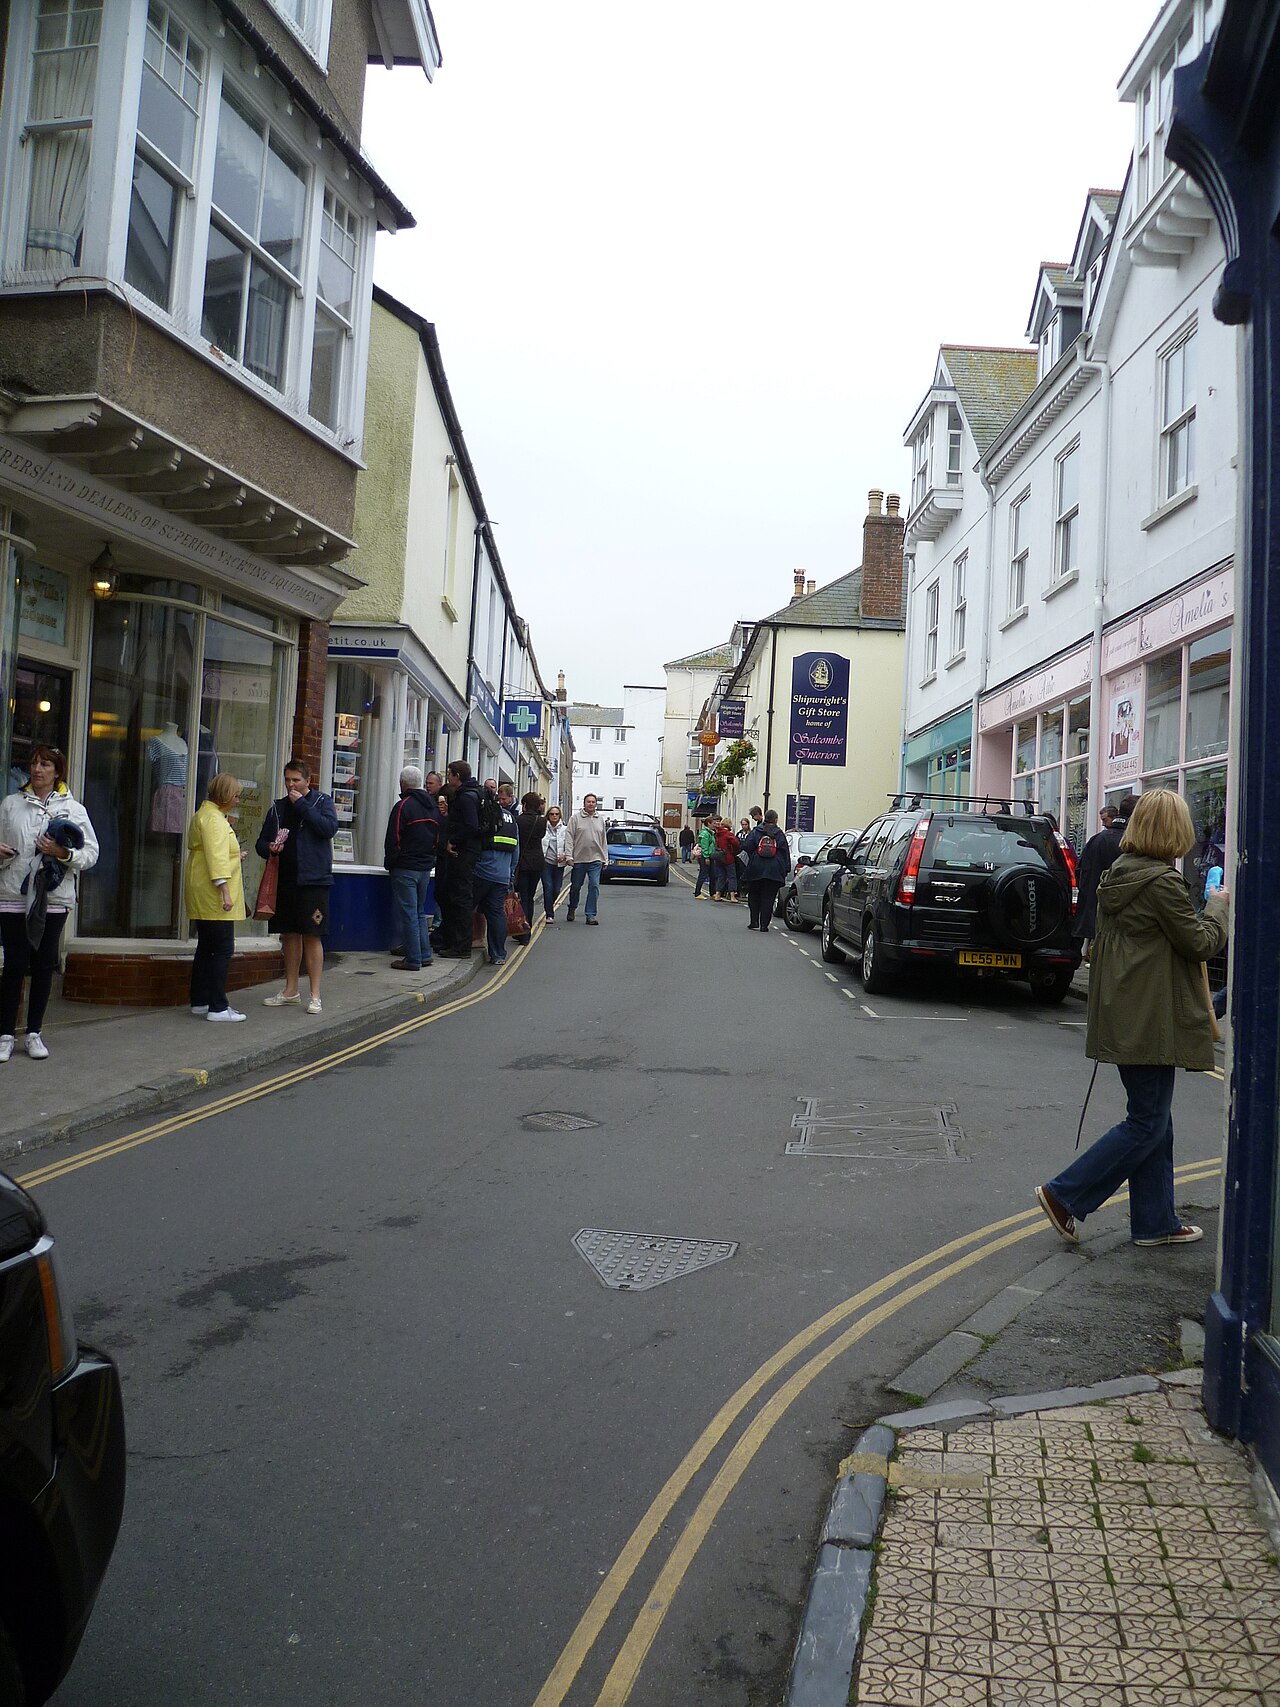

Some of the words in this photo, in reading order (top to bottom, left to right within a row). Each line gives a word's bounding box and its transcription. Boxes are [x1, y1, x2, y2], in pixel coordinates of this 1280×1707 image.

[0, 447, 43, 478] RERS
[42, 472, 77, 492] AND
[76, 485, 141, 523] DEALERS
[140, 514, 161, 531] OF
[158, 523, 217, 558] SUPERIOR
[217, 550, 269, 582] YACHTING
[268, 573, 326, 606] EQUIPMENT
[792, 694, 847, 706] Shipwright's
[798, 707, 816, 718] Gift
[817, 708, 841, 717] Store
[805, 719, 823, 727] home
[824, 720, 833, 729] of
[792, 732, 844, 745] Salcombe
[794, 747, 841, 760] Interiors
[1027, 879, 1037, 933] HONDA
[963, 952, 992, 964] LC55
[995, 954, 1017, 966] PWN
